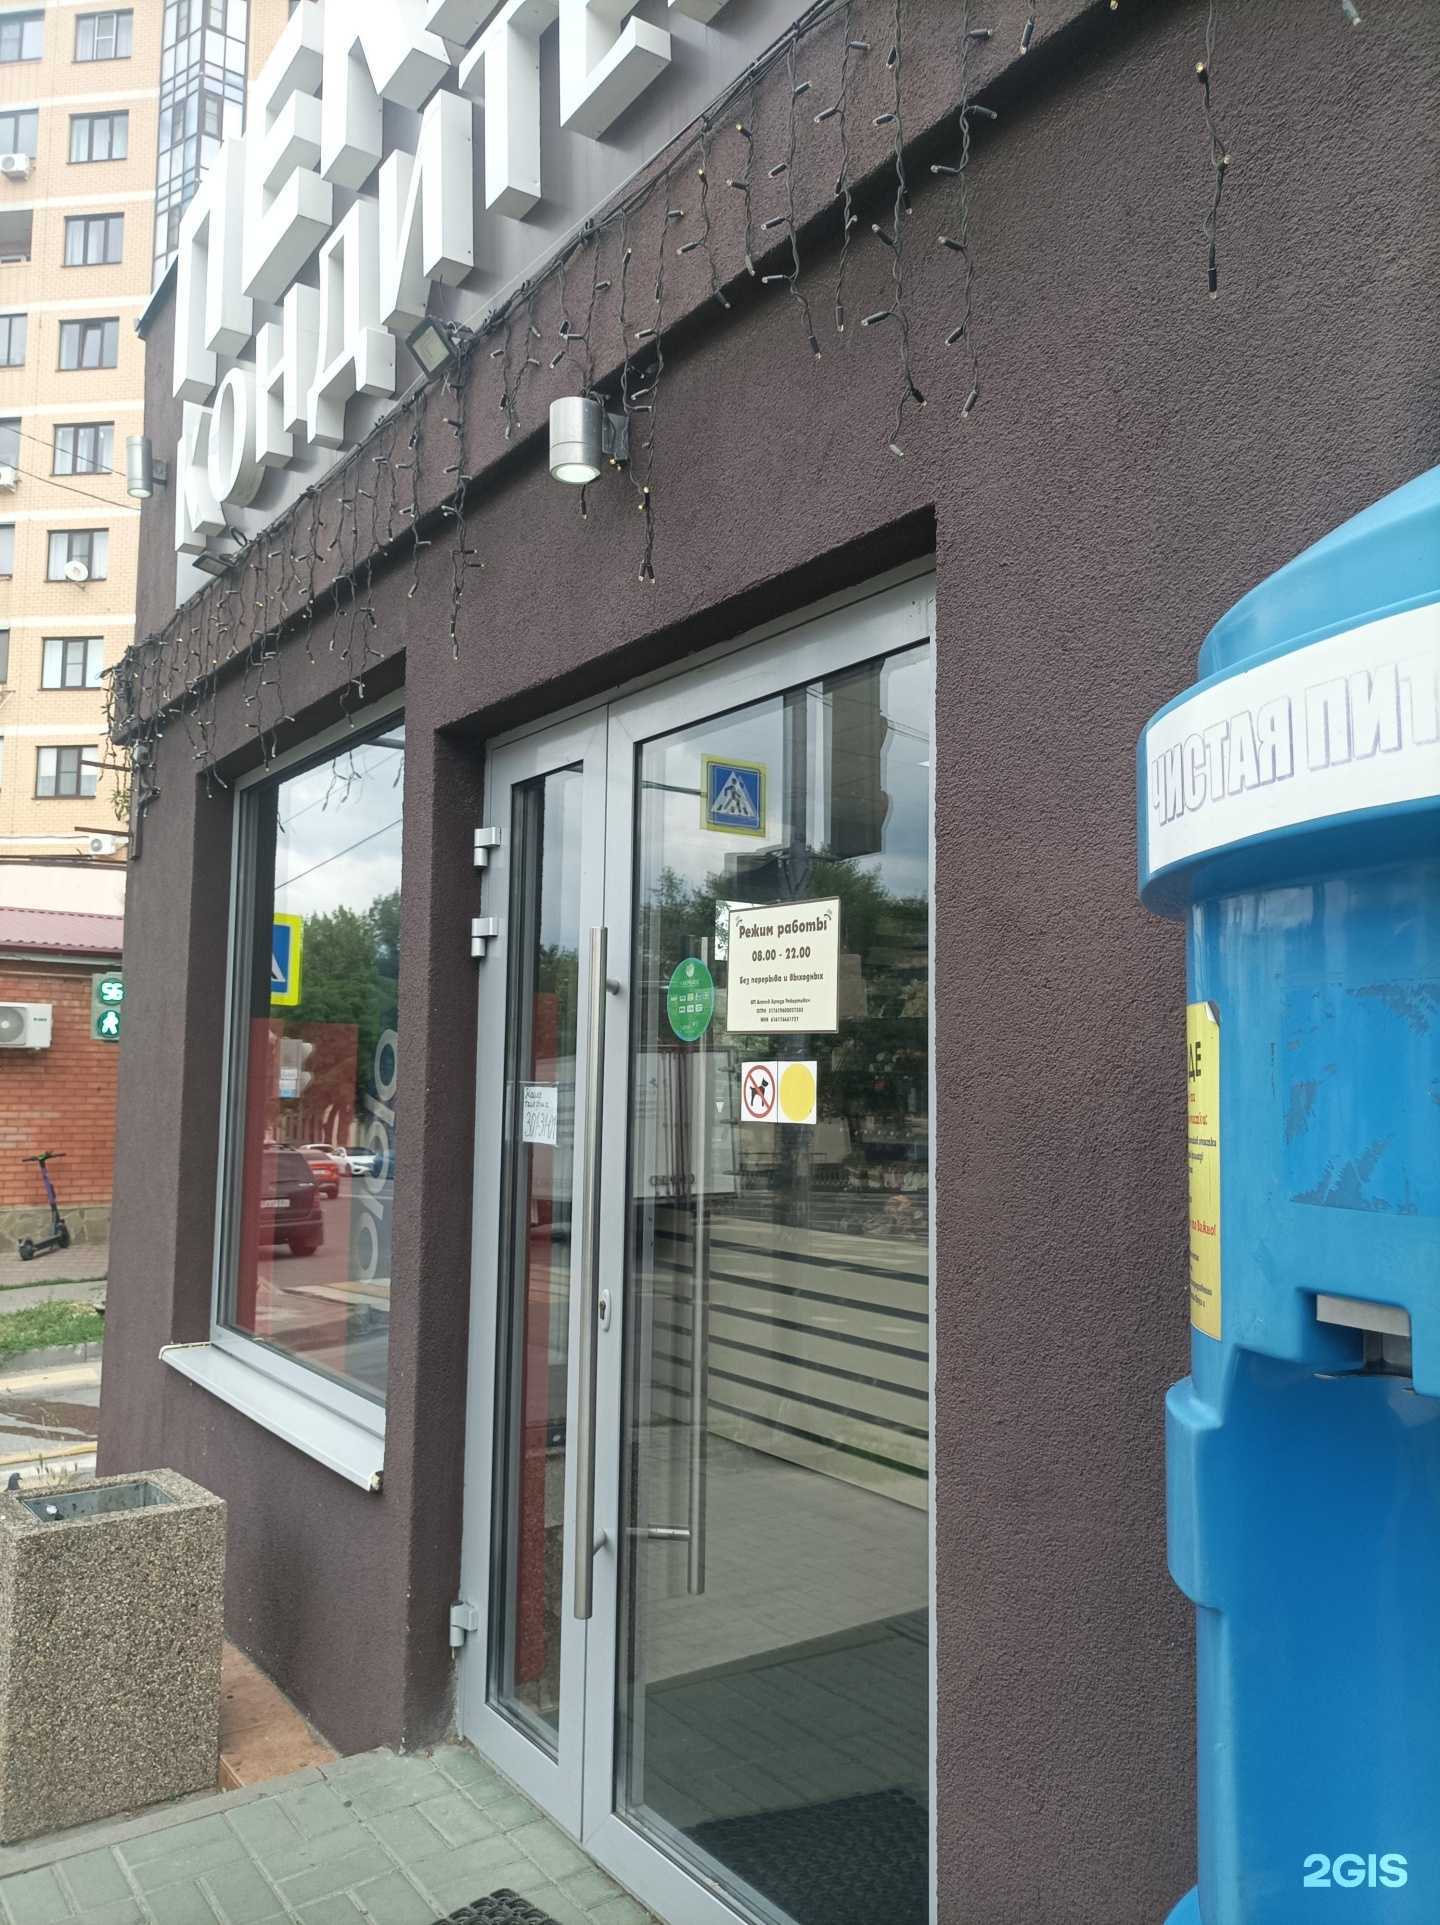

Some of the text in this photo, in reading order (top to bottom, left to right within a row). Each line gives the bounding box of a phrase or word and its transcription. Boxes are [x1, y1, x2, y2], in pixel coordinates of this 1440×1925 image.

[174, 0, 737, 554] КОНДИТЕ
[1151, 695, 1294, 827] ЧИСТАЯ
[739, 917, 827, 939] Режим работы
[752, 949, 776, 962] 08.00
[785, 946, 811, 960] 22.00
[739, 976, 750, 986] Без
[751, 973, 782, 985] перерыва
[789, 972, 824, 983] выходных
